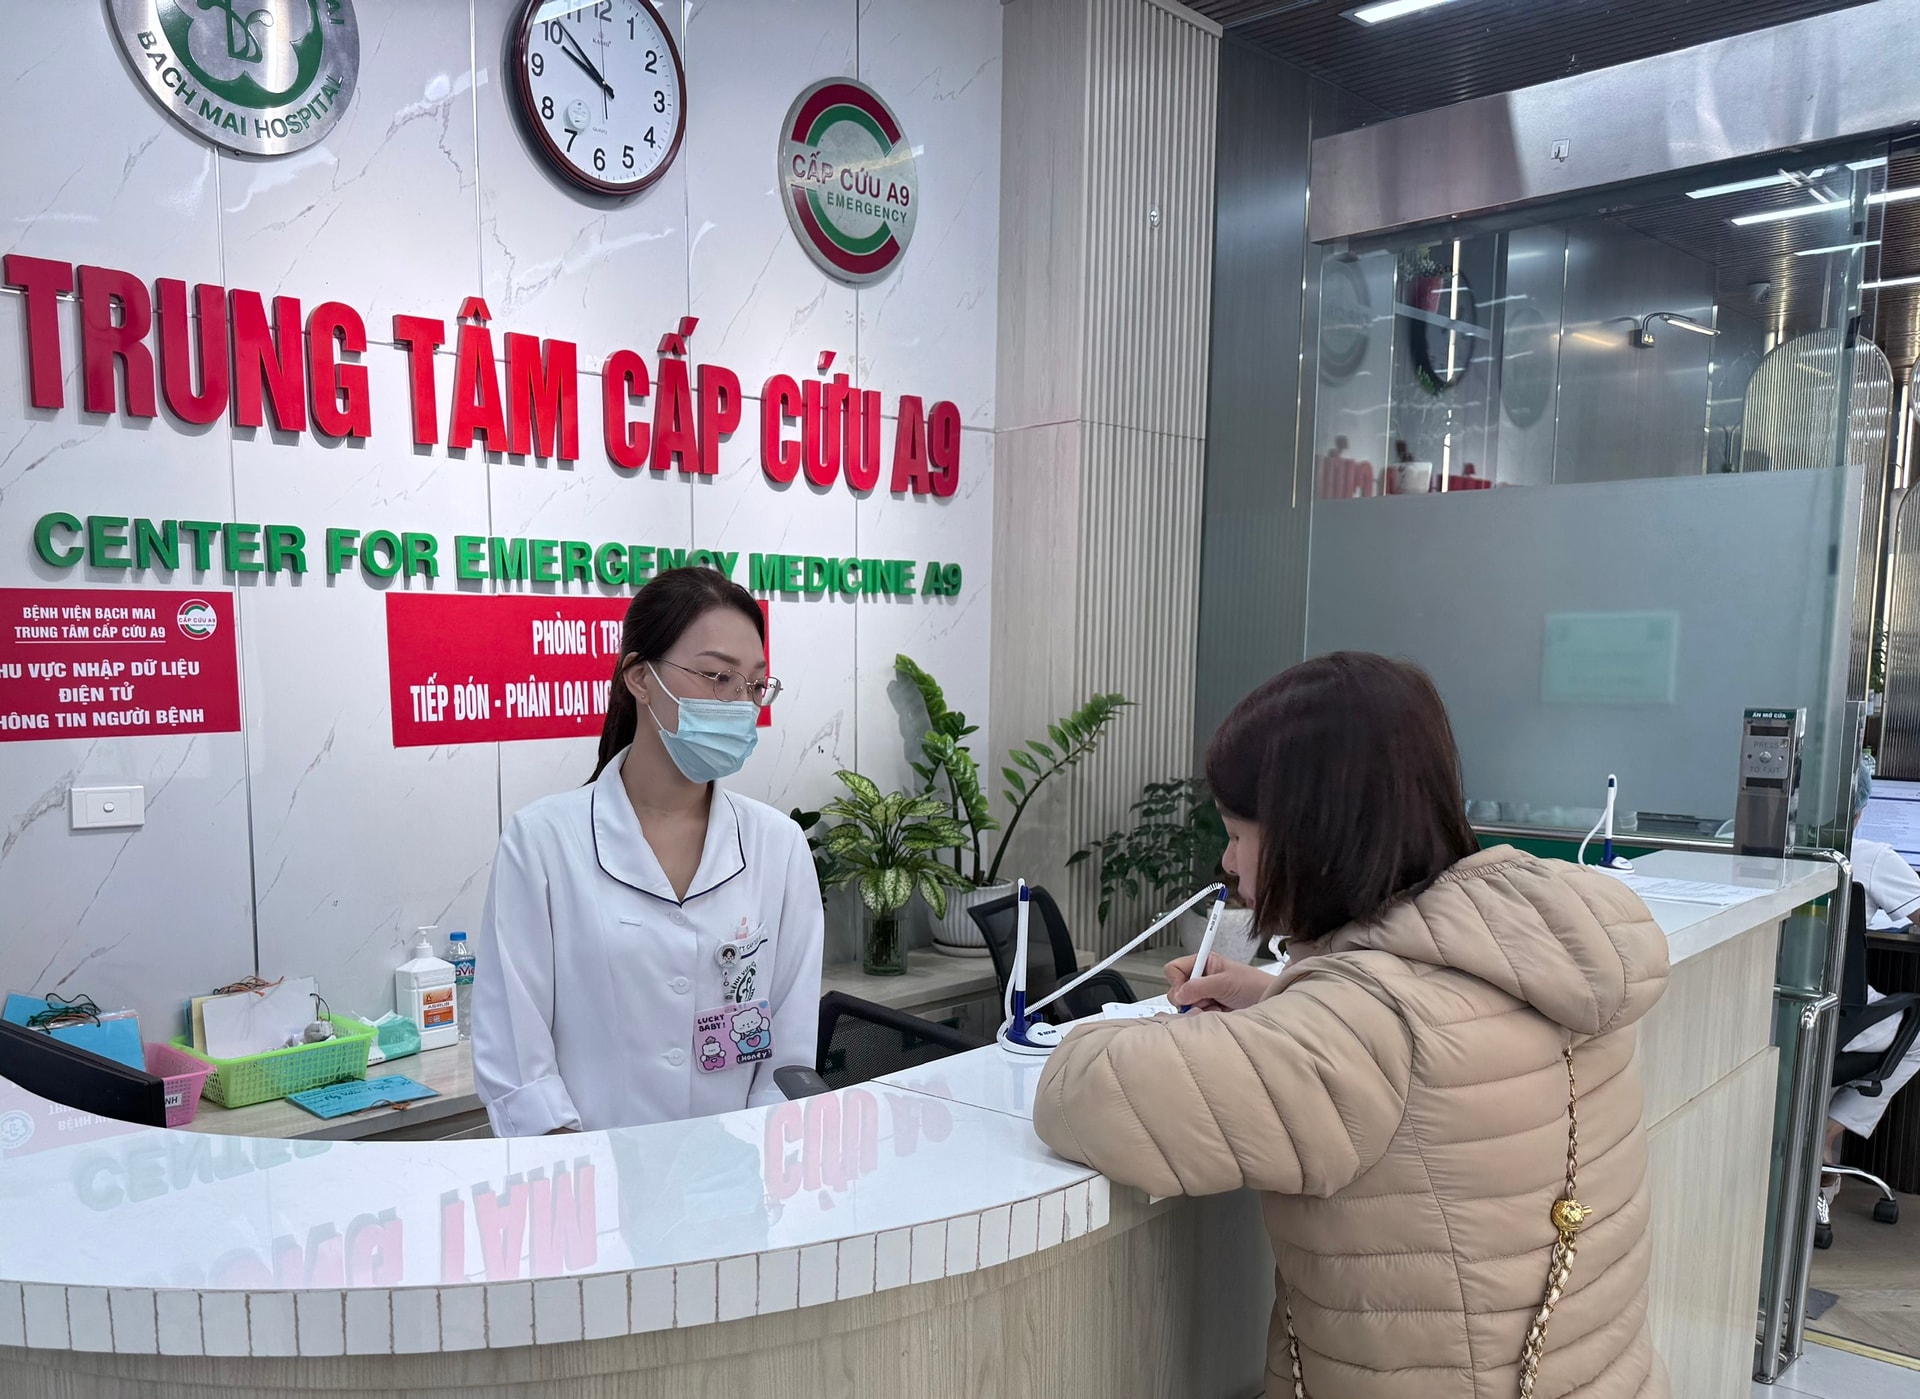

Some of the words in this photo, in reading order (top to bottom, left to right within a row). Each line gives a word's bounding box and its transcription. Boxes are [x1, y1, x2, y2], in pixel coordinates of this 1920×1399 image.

[326, 0, 345, 24] AI
[594, 0, 612, 22] 12
[541, 20, 563, 44] 10
[626, 17, 635, 40] 1
[531, 53, 544, 77] 9
[645, 50, 657, 74] 2
[137, 31, 197, 105] BACH
[199, 98, 247, 136] MAI
[255, 75, 344, 139] HOSPITAL
[541, 96, 554, 120] 8
[653, 90, 665, 113] 3
[564, 128, 578, 152] 7
[643, 126, 656, 148] 4
[593, 148, 606, 171] 6
[622, 145, 634, 169] 5
[792, 151, 833, 184] CẤP
[840, 168, 880, 198] CỨU
[887, 182, 909, 207] A9
[827, 191, 907, 224] EMERGENCY
[4, 254, 371, 438] TRUNG
[392, 296, 579, 460] TÂM
[602, 316, 741, 475] CẤP
[761, 350, 881, 491] CỨU
[891, 394, 962, 497] A9
[34, 512, 308, 573] CENTER
[326, 528, 440, 579] FOR
[748, 552, 917, 595] MEDICINE
[921, 561, 962, 596] A9
[23, 605, 59, 621] BỆNH
[62, 605, 92, 621] VIỆN
[95, 607, 129, 622] BẠCH
[132, 607, 156, 619] MAI
[14, 626, 58, 639] TRUNG
[61, 625, 90, 639] TÂM
[93, 623, 118, 638] CẤP
[122, 625, 147, 638] CỨU
[150, 627, 166, 638] A9
[532, 611, 587, 656] PHÒNG
[27, 661, 66, 681] VỰC
[73, 659, 125, 680] NHẬP
[131, 658, 158, 677] DỮ
[161, 658, 200, 678] LIỆU
[58, 684, 104, 705] ĐIỆN
[110, 681, 135, 701] TỬ
[410, 672, 449, 723] TIẾP
[453, 676, 490, 720] ĐÓN
[505, 675, 551, 718] PHÂN
[554, 680, 589, 723] LOẠI
[55, 713, 87, 728] TIN
[92, 706, 151, 727] NGƯỜI
[156, 707, 204, 726] BỆNH
[1763, 766, 1780, 774] EXIT
[697, 1014, 725, 1025] LUCKY
